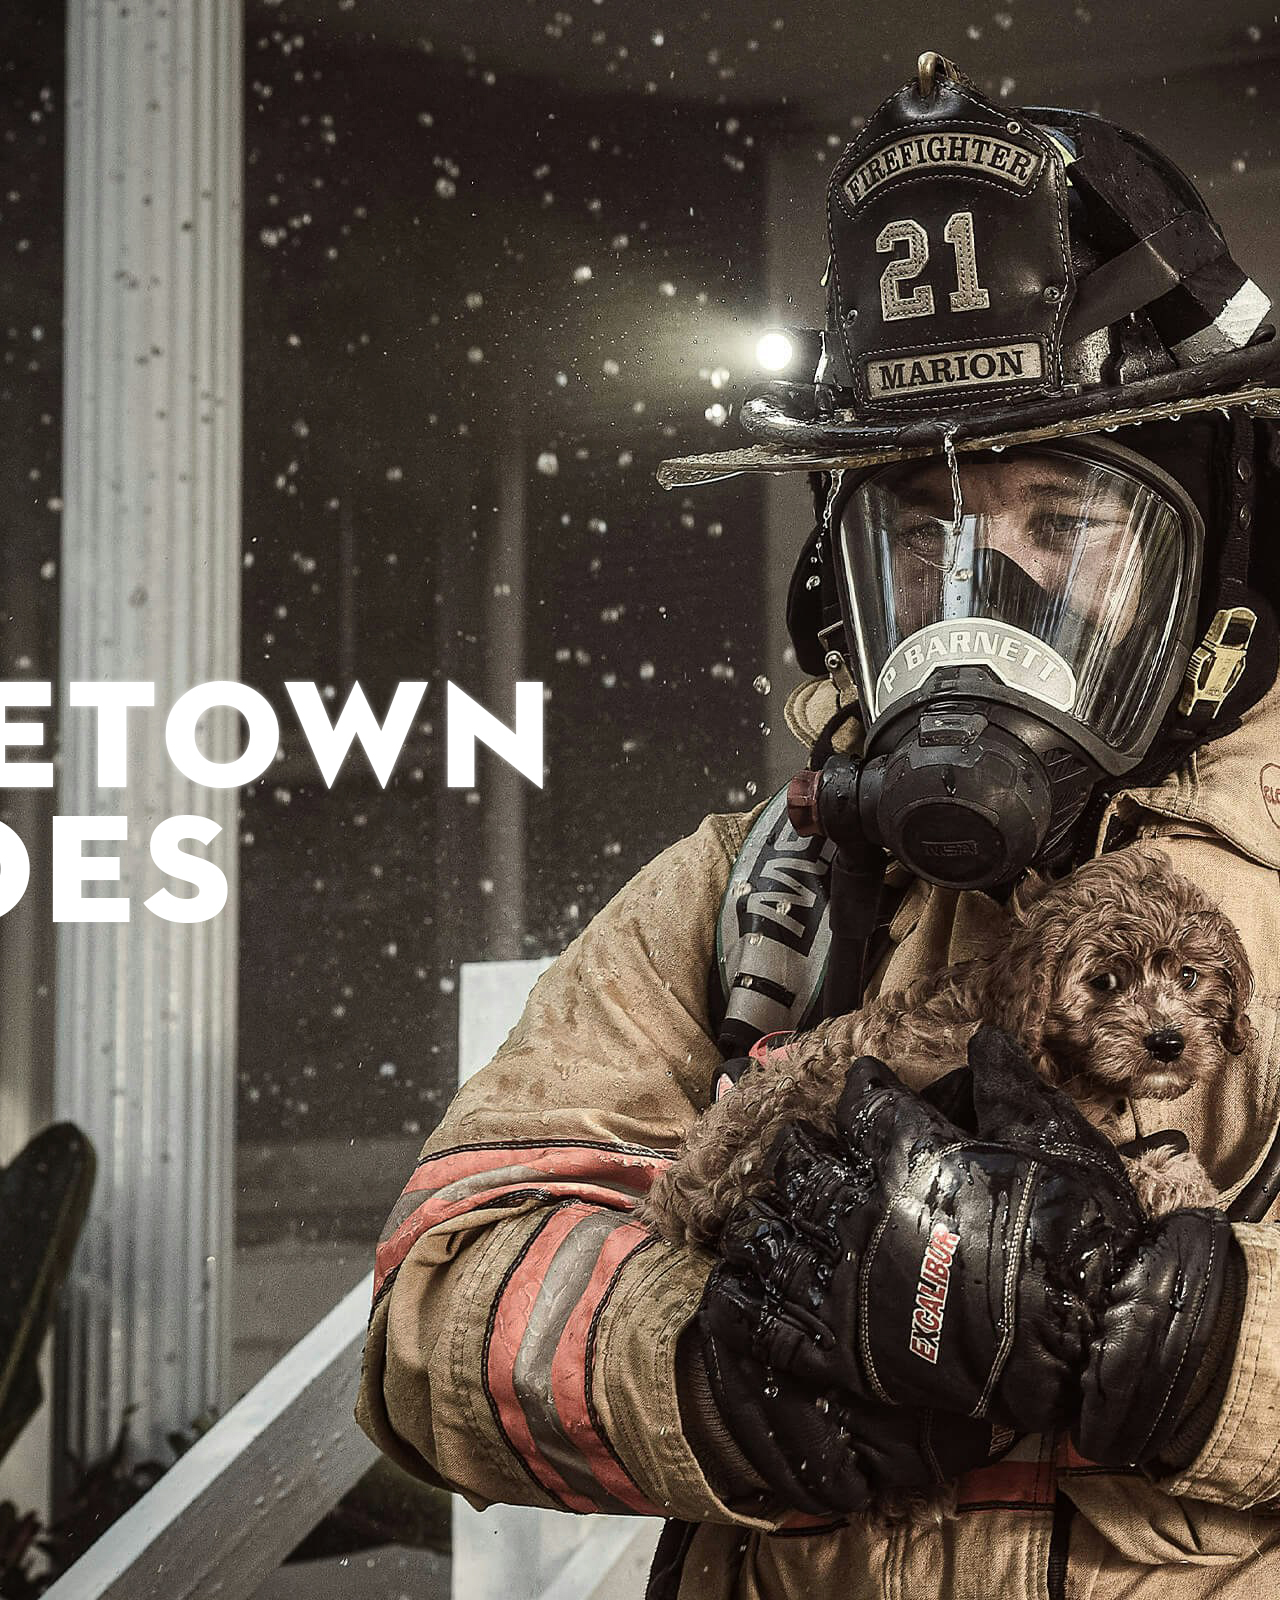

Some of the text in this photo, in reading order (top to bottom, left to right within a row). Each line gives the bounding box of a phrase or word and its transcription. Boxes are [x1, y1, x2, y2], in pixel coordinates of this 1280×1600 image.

[847, 136, 1032, 201] FIREFIGHTER
[876, 211, 991, 322] 21
[880, 350, 1024, 390] MARION
[882, 631, 1063, 694] P BARNETT
[910, 1222, 960, 1364] EXCALIBUR
